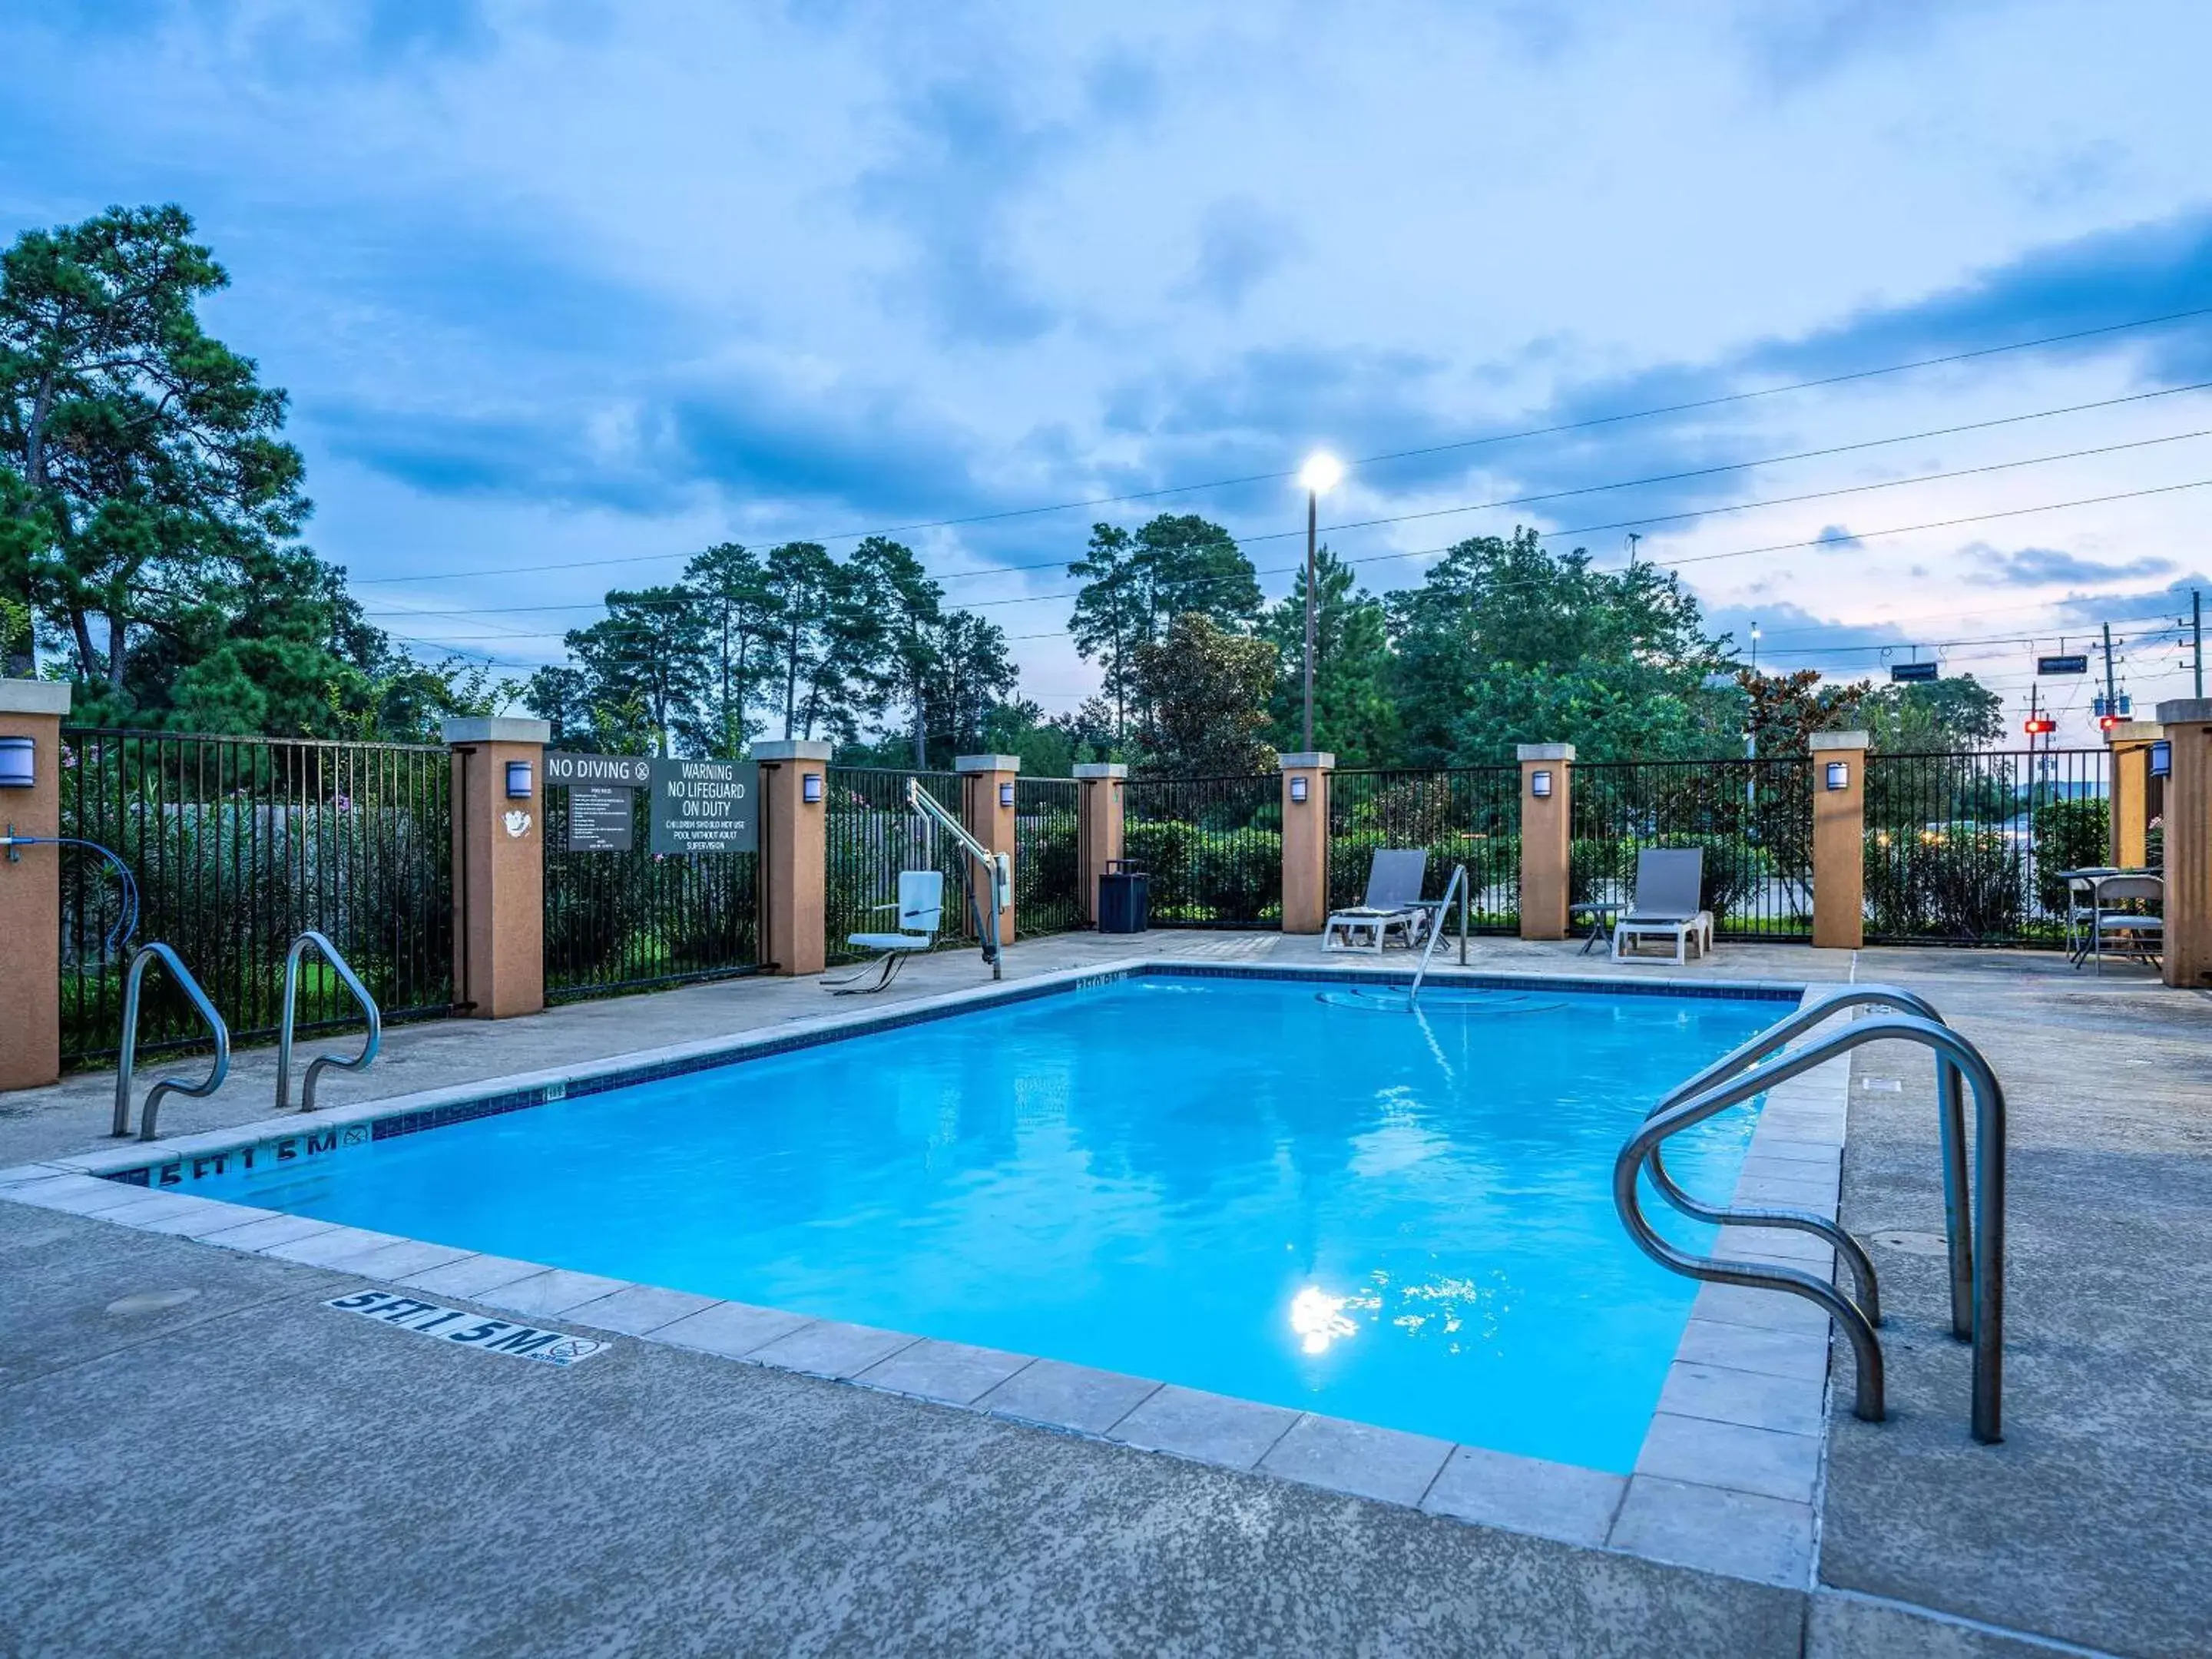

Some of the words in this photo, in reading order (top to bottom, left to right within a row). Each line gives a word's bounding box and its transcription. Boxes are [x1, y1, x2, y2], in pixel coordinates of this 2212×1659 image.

[549, 759, 573, 777] NO
[578, 760, 630, 780] DIVING
[681, 762, 733, 781] WARNING
[667, 780, 685, 797] NO
[687, 781, 745, 799] LIFEGUARD
[682, 800, 700, 816] ON
[702, 800, 731, 816] DUTY
[673, 830, 690, 840] POOL
